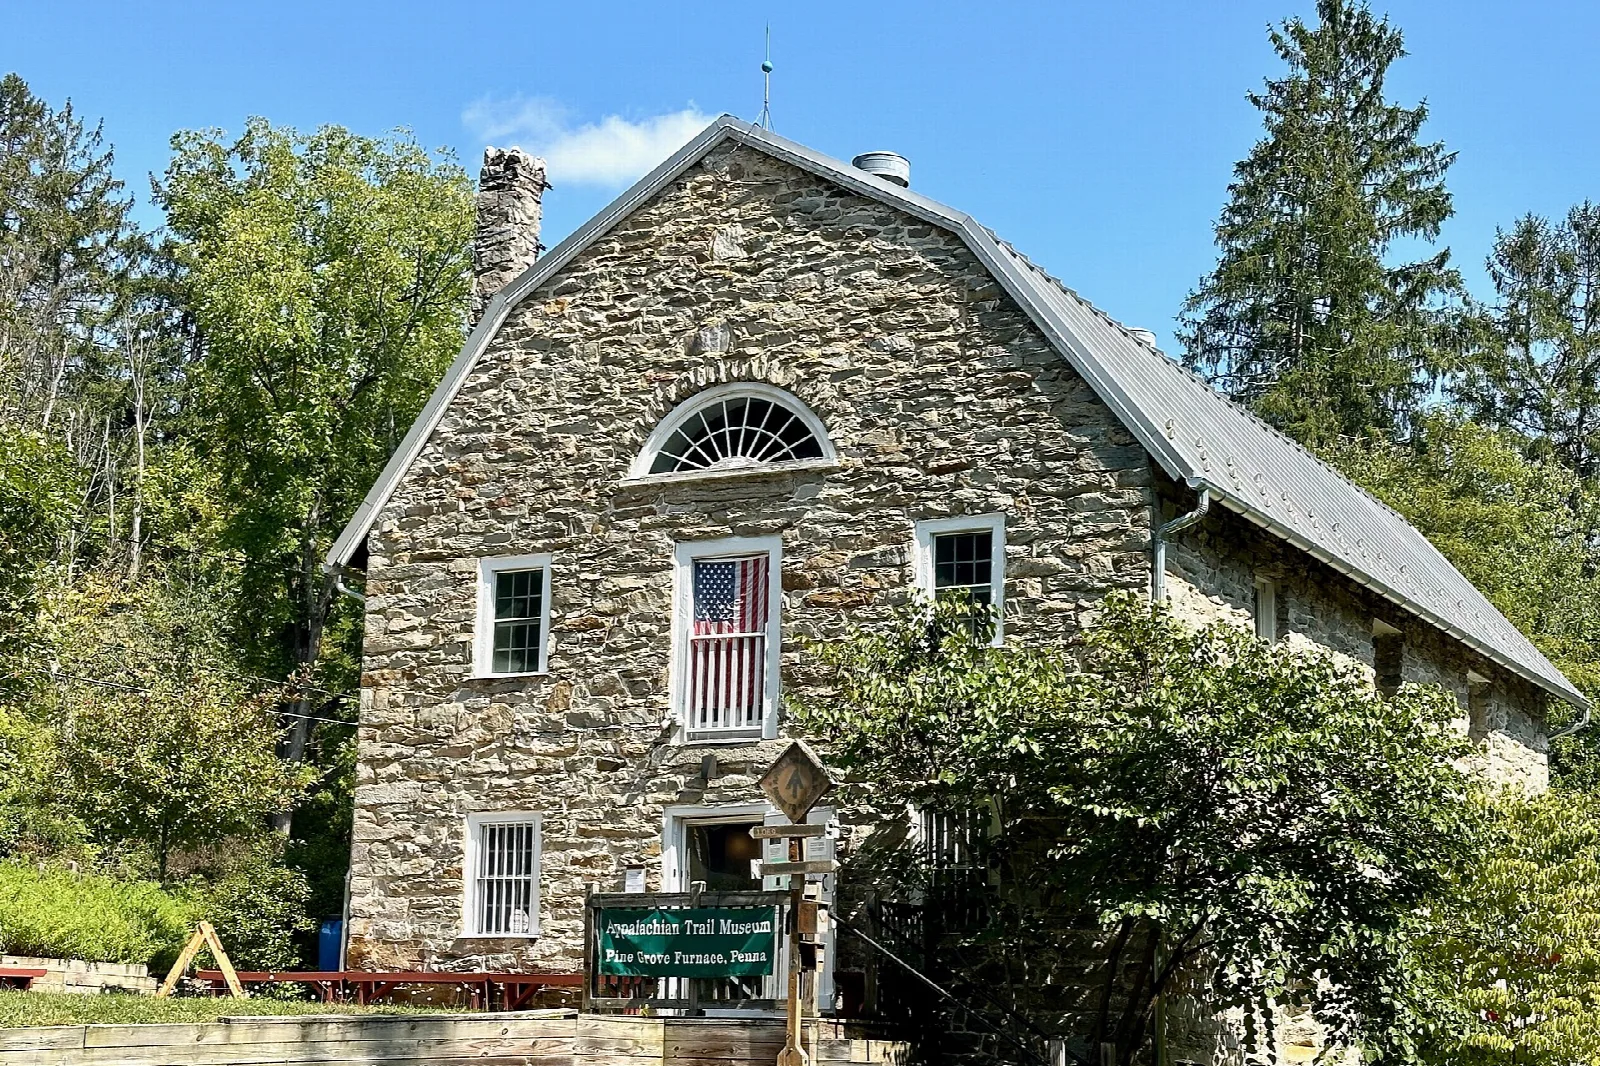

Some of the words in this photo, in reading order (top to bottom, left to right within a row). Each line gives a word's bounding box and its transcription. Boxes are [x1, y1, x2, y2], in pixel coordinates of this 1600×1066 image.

[605, 918, 680, 939] Appalachian
[684, 918, 715, 935] Trail
[718, 919, 771, 935] Museum
[605, 948, 634, 963] Pine
[636, 951, 671, 965] Grove
[674, 951, 728, 966] Furnace,
[730, 949, 767, 963] Penna
